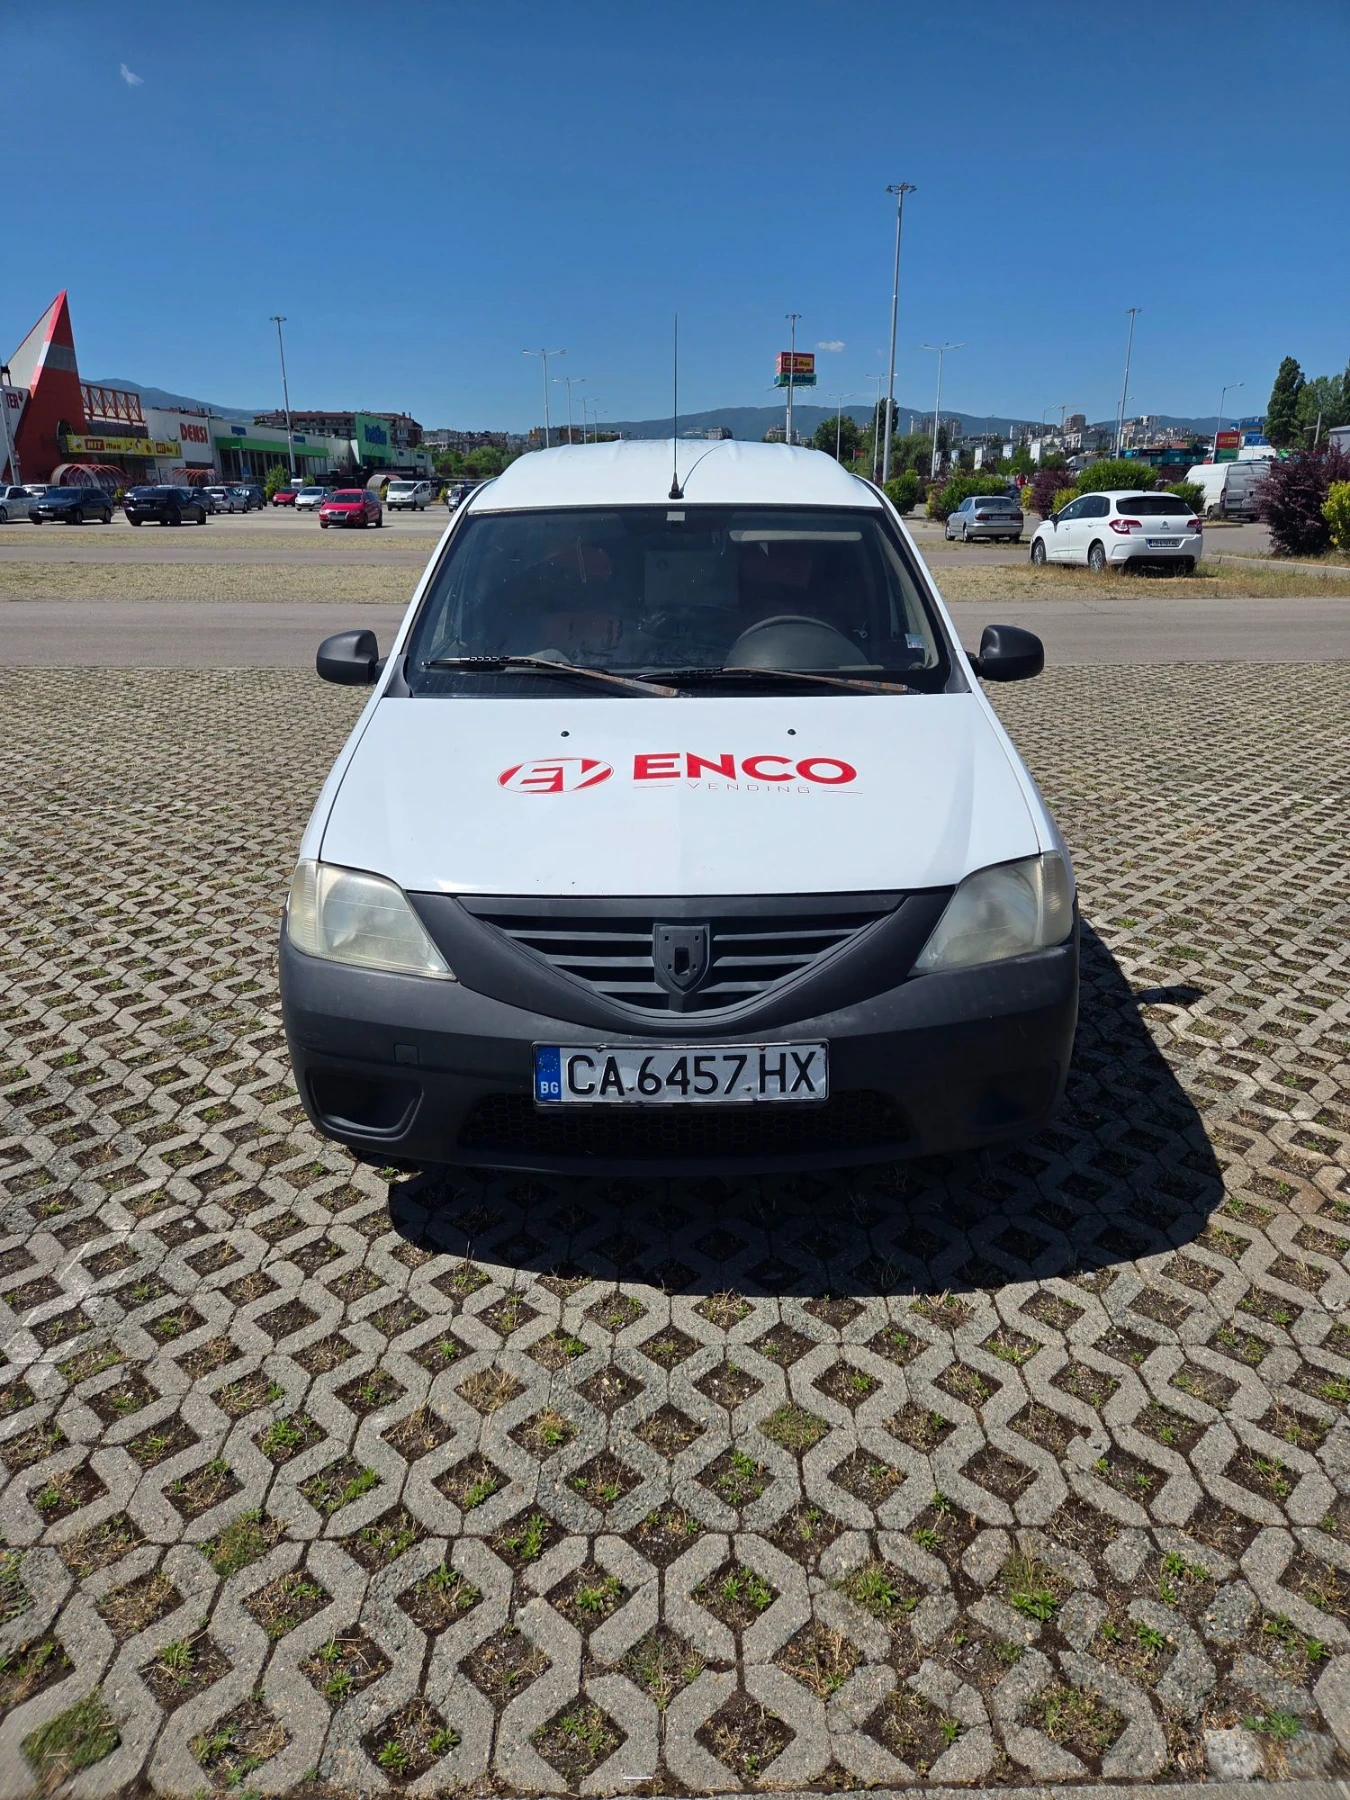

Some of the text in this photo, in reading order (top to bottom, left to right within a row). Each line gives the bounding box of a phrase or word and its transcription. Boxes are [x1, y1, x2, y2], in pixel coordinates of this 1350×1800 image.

[180, 422, 208, 444] DENSI
[632, 751, 858, 785] ENCO
[687, 782, 811, 794] VENDING
[540, 1081, 559, 1094] BG
